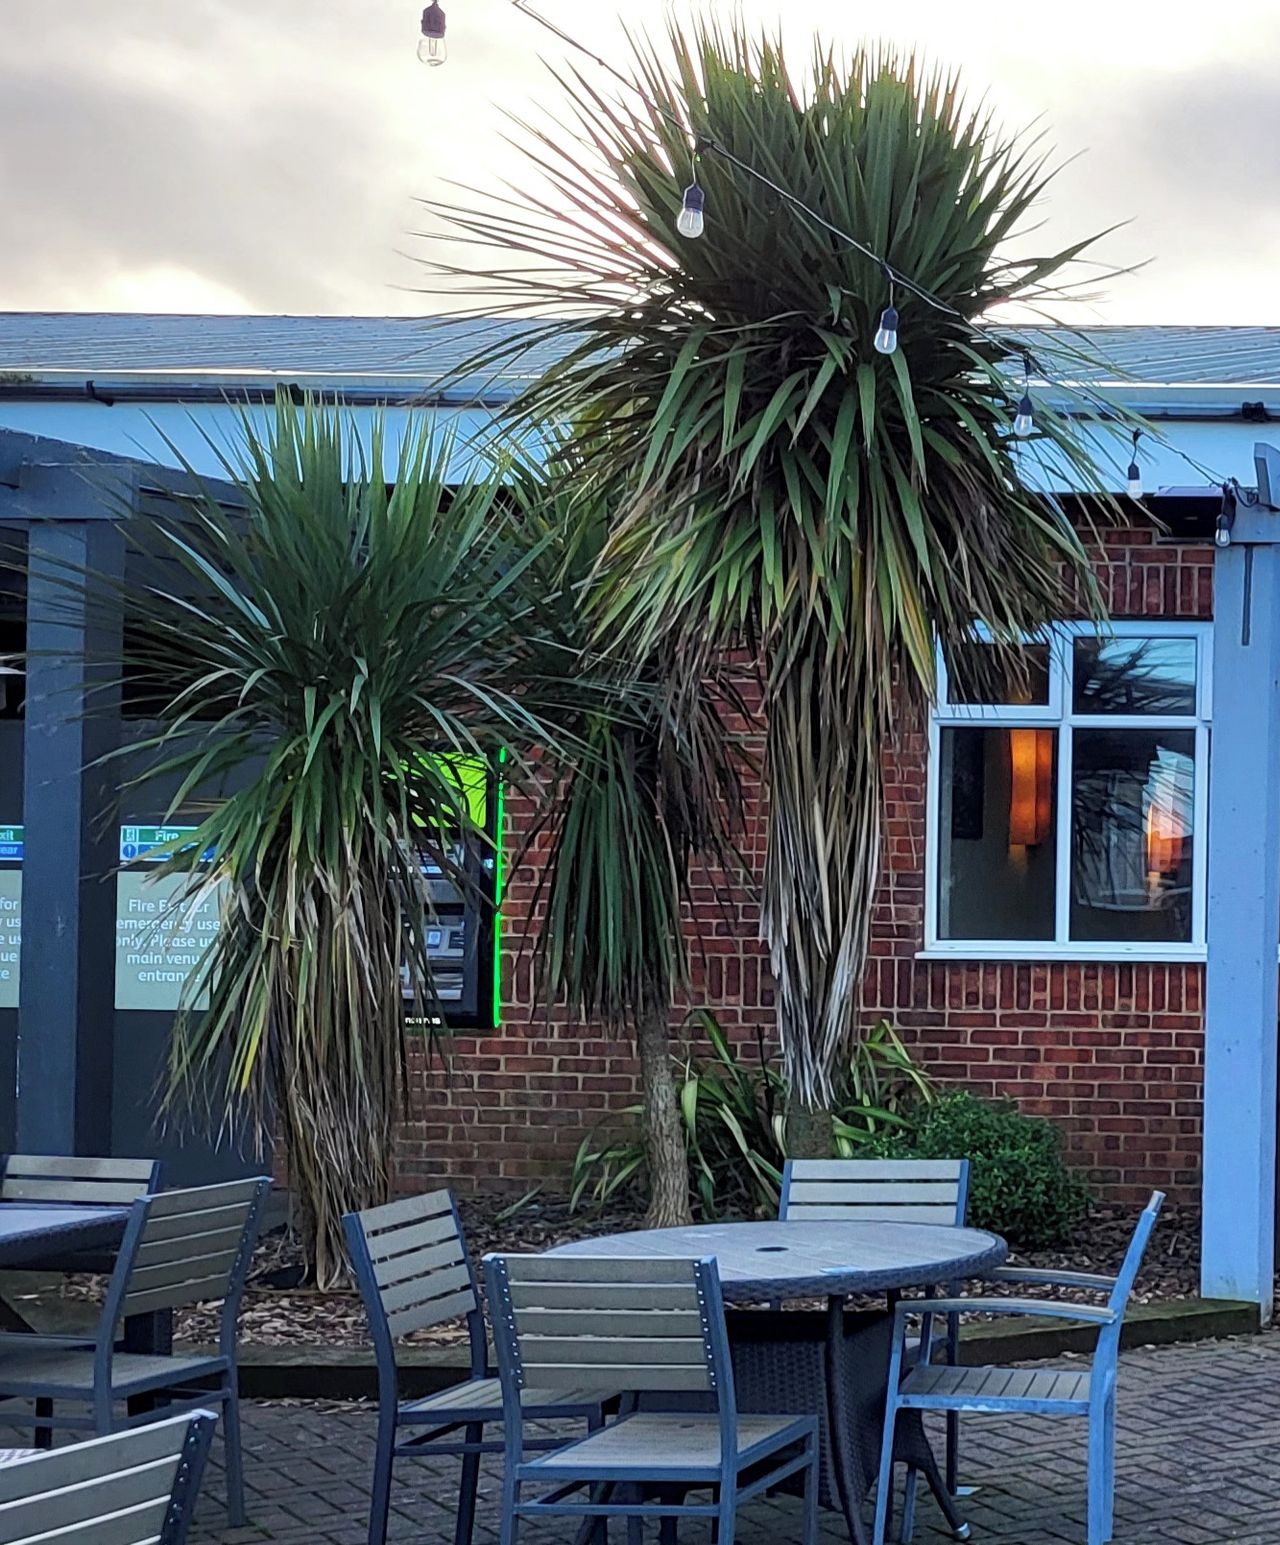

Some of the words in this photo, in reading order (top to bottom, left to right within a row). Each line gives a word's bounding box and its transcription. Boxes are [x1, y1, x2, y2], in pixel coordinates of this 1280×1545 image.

[155, 831, 179, 842] Fire
[129, 899, 155, 912] Fire
[6, 918, 21, 928] us
[197, 920, 221, 930] use
[199, 937, 214, 947] us
[127, 953, 162, 964] main
[166, 954, 200, 965] venu
[138, 970, 200, 982] entran
